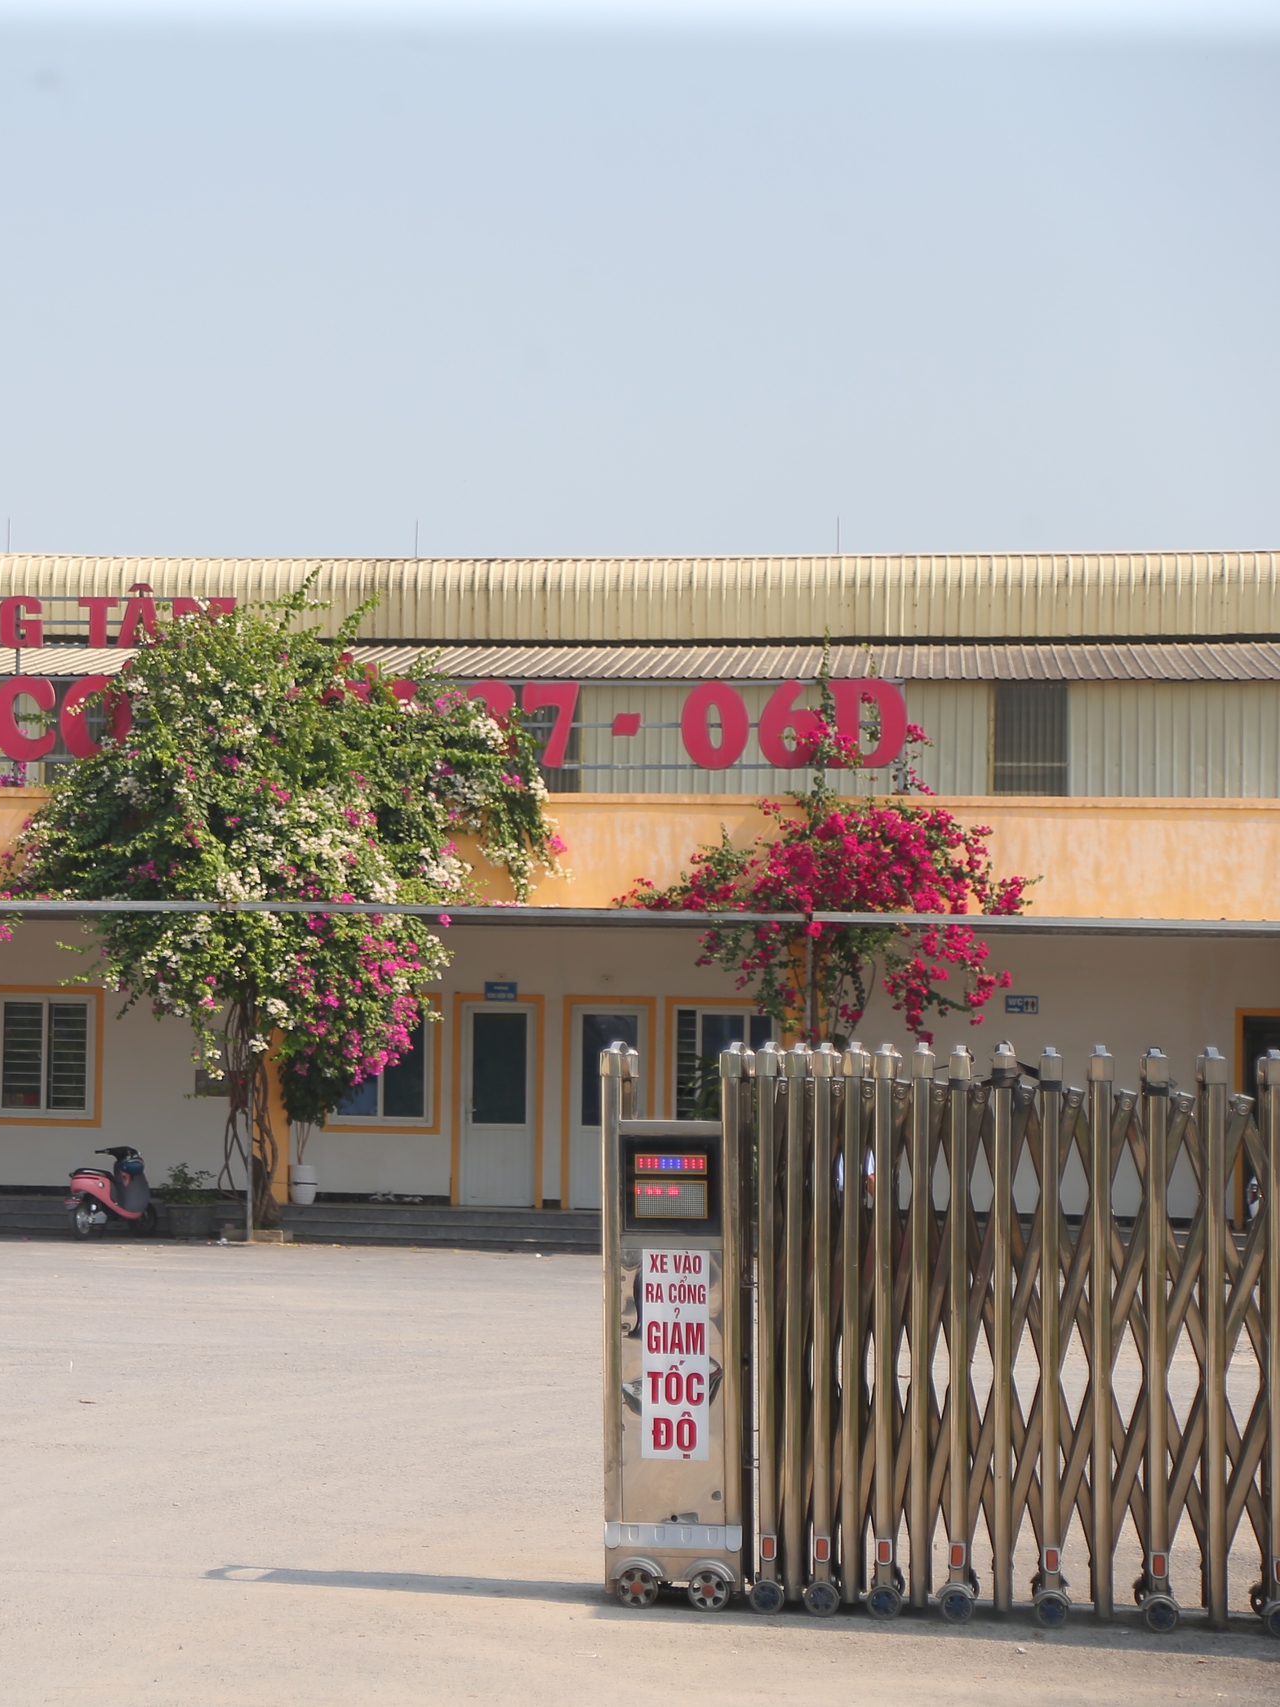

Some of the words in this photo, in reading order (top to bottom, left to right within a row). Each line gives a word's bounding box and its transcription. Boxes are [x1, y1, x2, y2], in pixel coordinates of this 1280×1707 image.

[681, 678, 909, 770] 06D
[649, 1254, 669, 1274] XE
[673, 1251, 702, 1274] VÀO
[645, 1283, 664, 1303] RA
[668, 1275, 706, 1304] CỔNG
[647, 1307, 705, 1356] GIẢM
[647, 1360, 705, 1407] TỐC
[651, 1411, 697, 1460] ĐỘ
